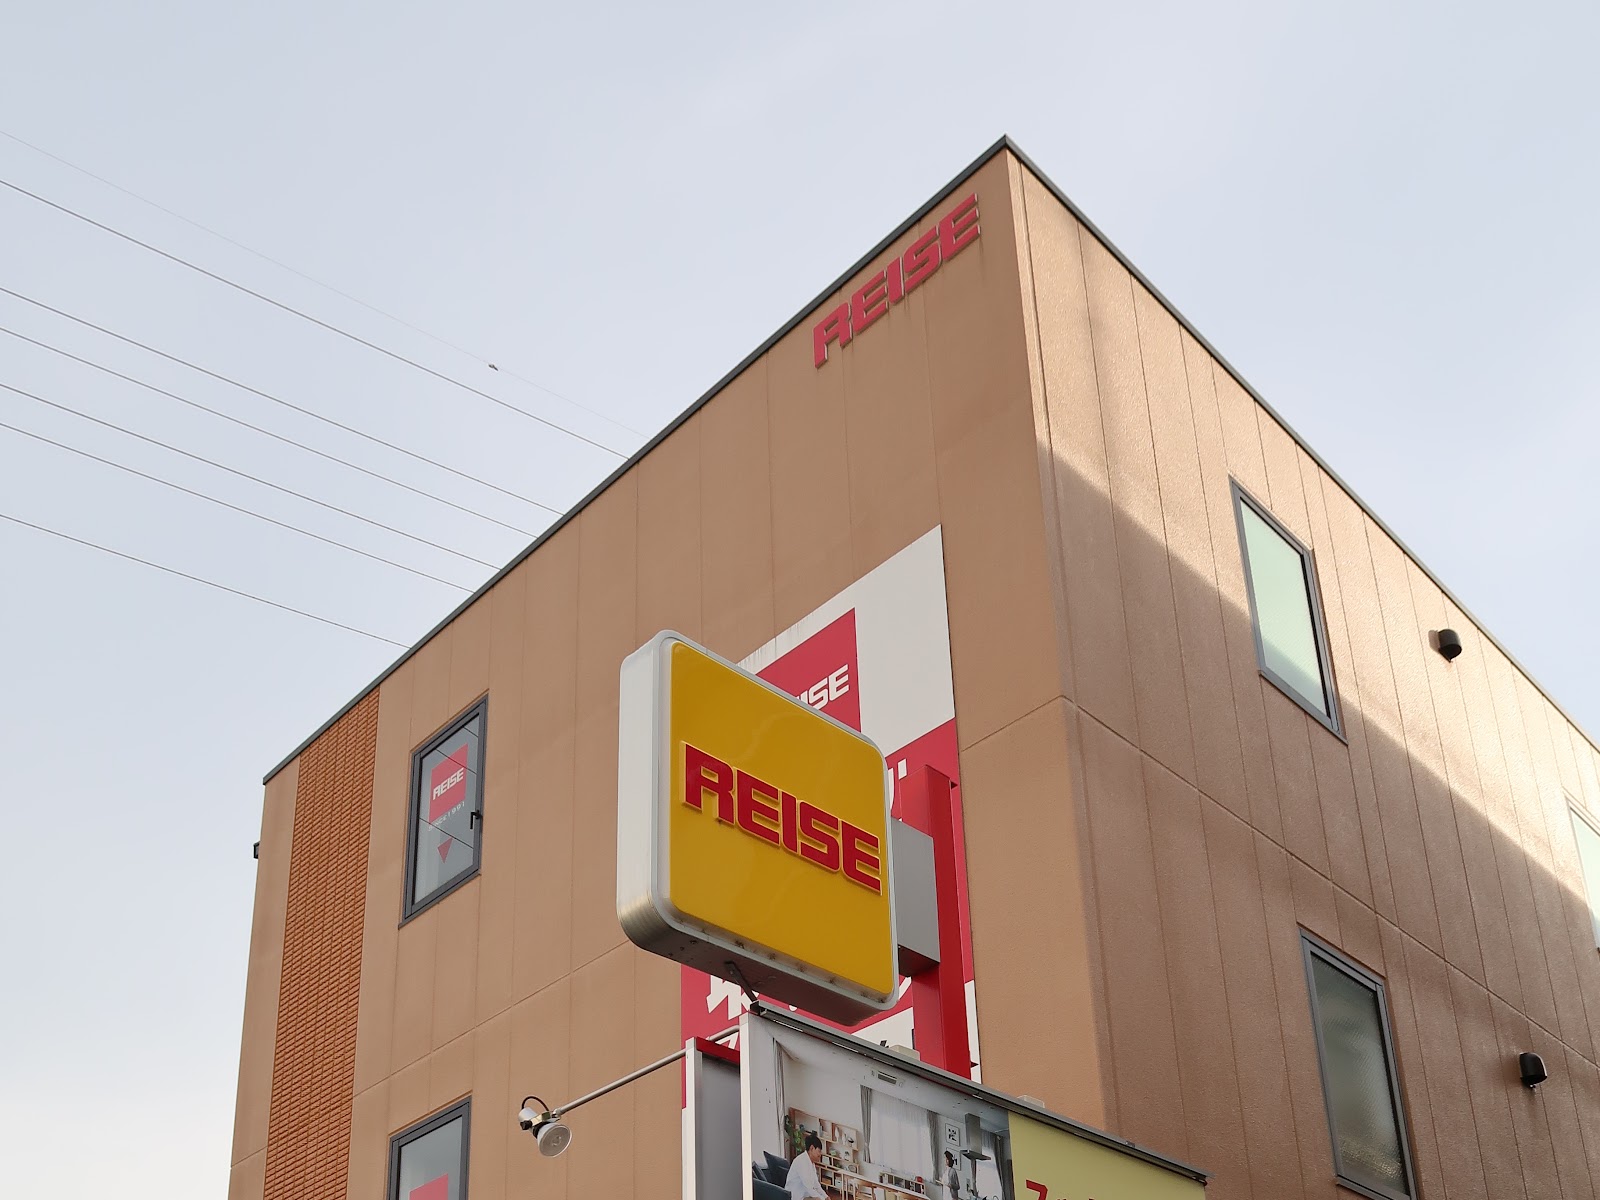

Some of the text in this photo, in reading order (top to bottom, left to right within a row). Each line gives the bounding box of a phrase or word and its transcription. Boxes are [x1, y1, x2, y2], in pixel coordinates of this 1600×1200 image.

[813, 192, 981, 369] REISE
[432, 768, 465, 800] REISE
[683, 741, 881, 895] REISE
